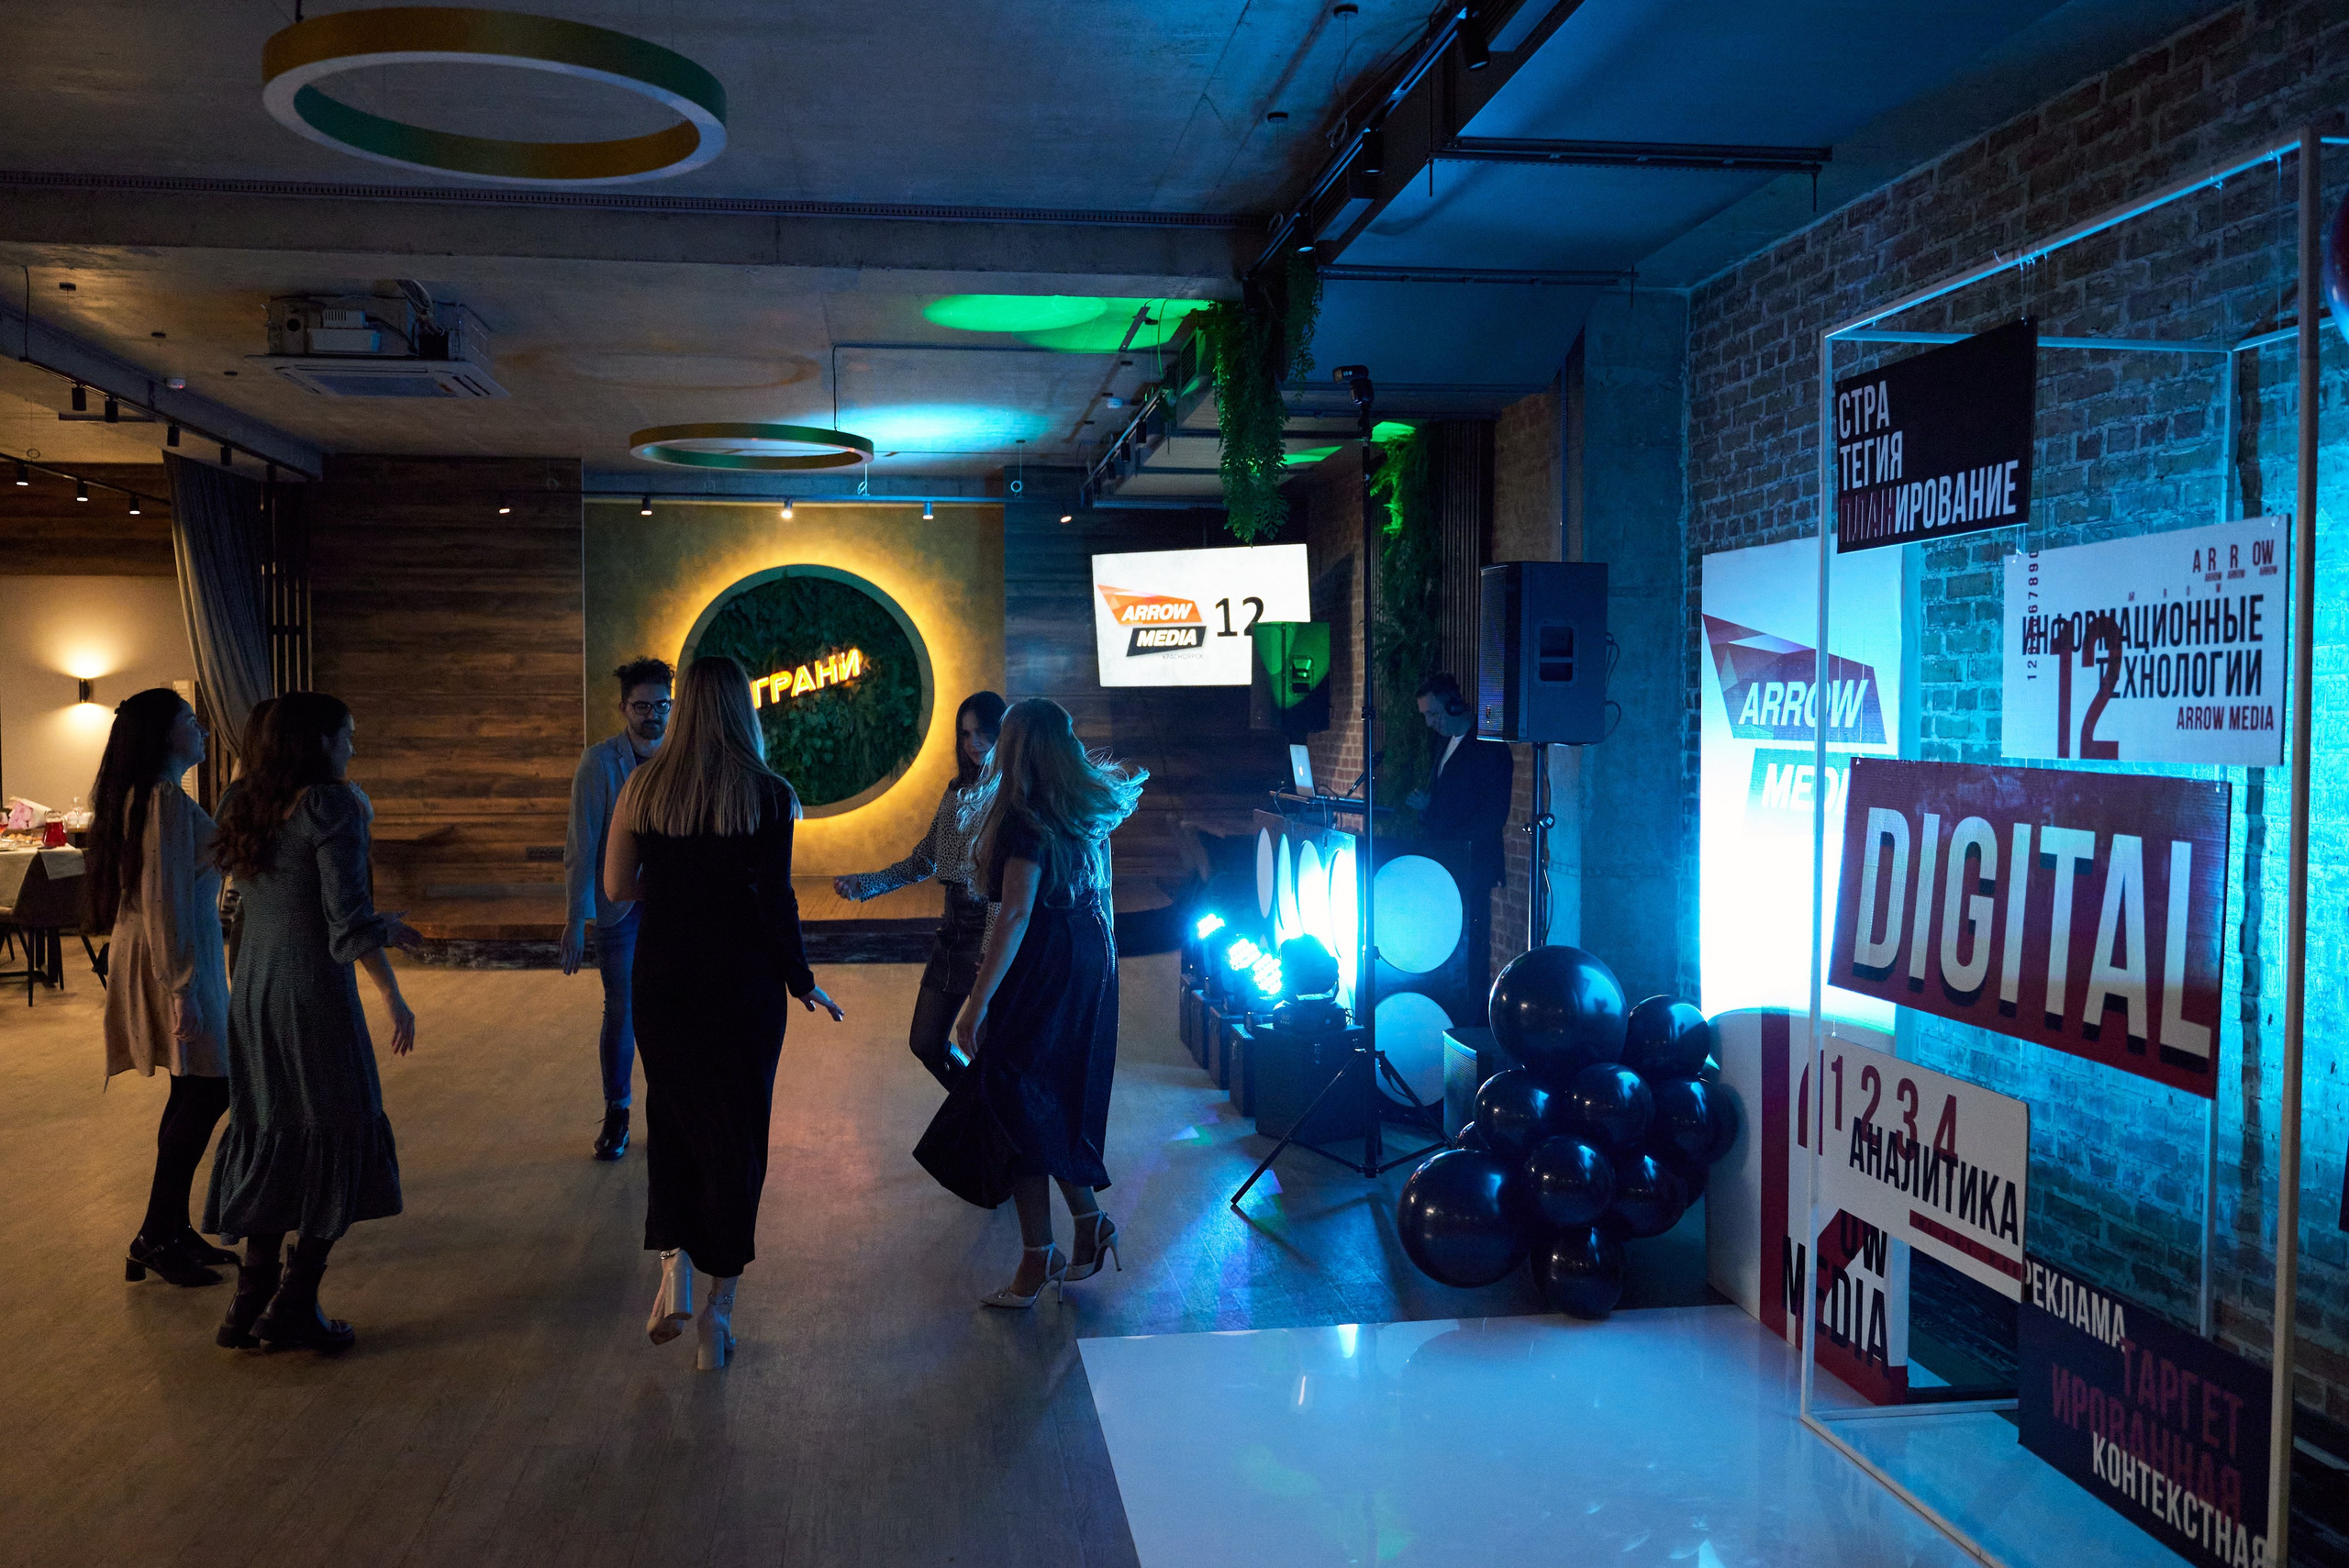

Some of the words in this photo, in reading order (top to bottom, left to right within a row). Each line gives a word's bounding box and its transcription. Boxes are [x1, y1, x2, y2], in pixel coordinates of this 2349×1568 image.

[1839, 380, 1889, 439] СТРА
[1840, 430, 1902, 491] ТЕГИЯ
[1840, 460, 2018, 543] ПЛАНИРОВАНИЕ
[1121, 603, 1192, 622] ARROW
[1136, 628, 1197, 647] MEDIA
[1215, 596, 1264, 637] 12
[2022, 595, 2264, 655] ИНФОРМАЦИОННЫЕ
[1738, 679, 1869, 728] ARROW
[2049, 615, 2123, 760] 12
[2176, 706, 2224, 730] ARROW
[2229, 705, 2274, 730] MEDIA
[1762, 763, 1850, 815] MEDI
[1853, 806, 2211, 1068] DIGITAL
[1850, 1116, 2019, 1246] АНАЛИТИКА
